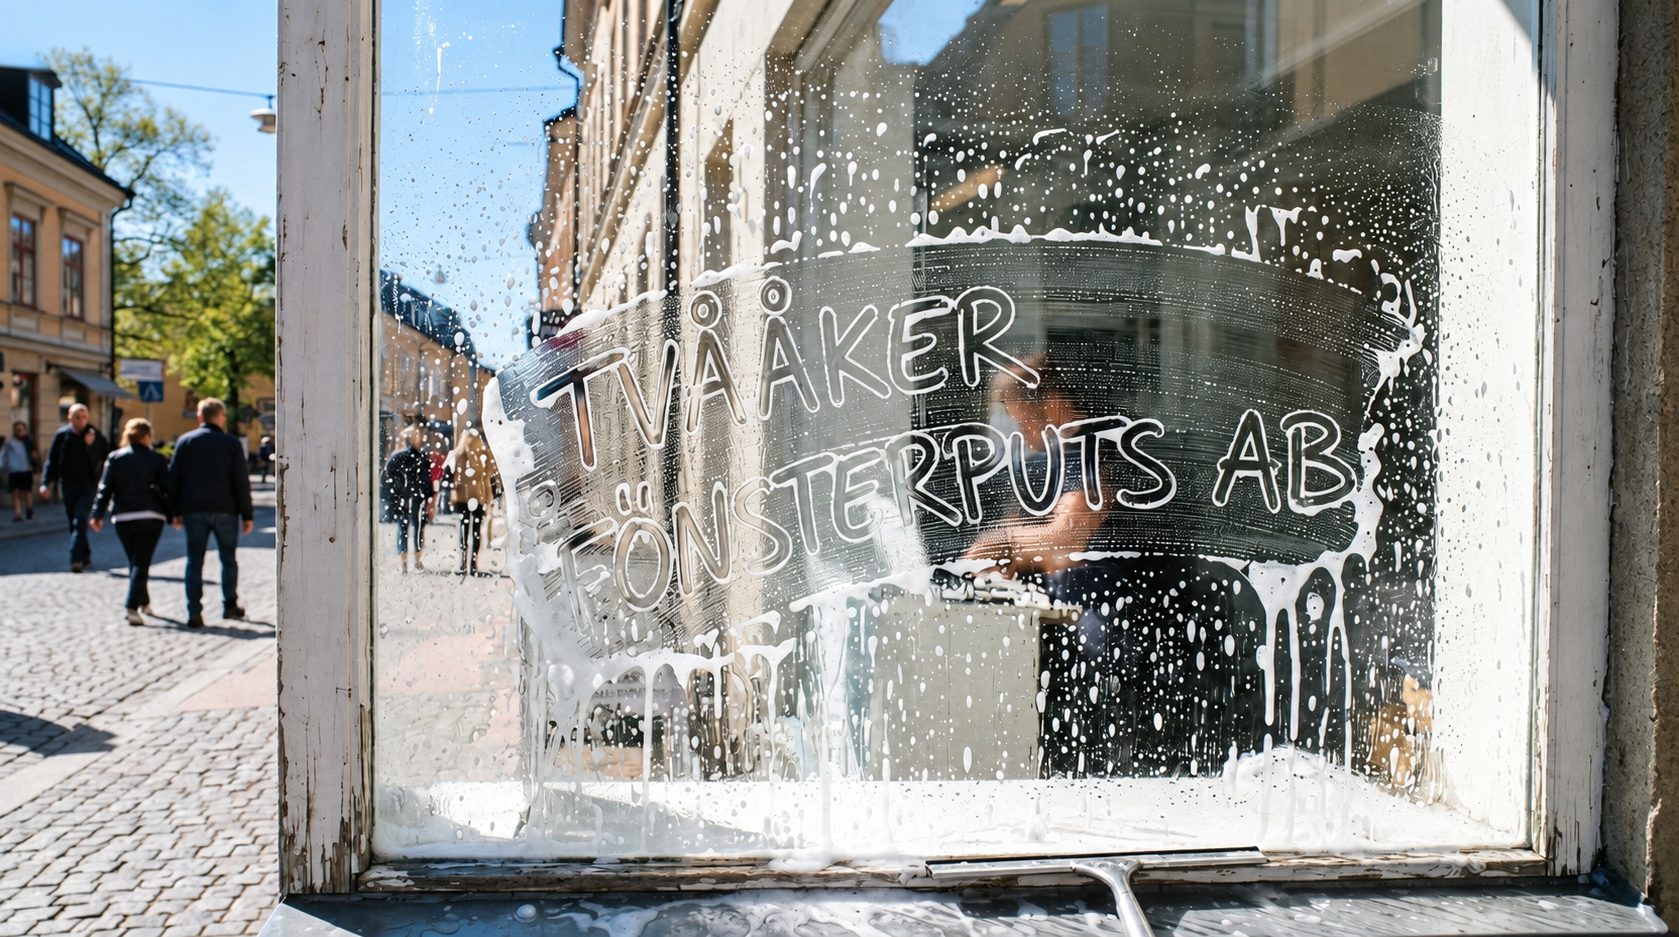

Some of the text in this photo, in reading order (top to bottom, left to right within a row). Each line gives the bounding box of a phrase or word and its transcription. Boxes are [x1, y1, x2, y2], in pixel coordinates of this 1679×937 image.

[530, 275, 1040, 471] TVÅÅKER
[557, 408, 1359, 637] FÖNSTERPUTS AB
